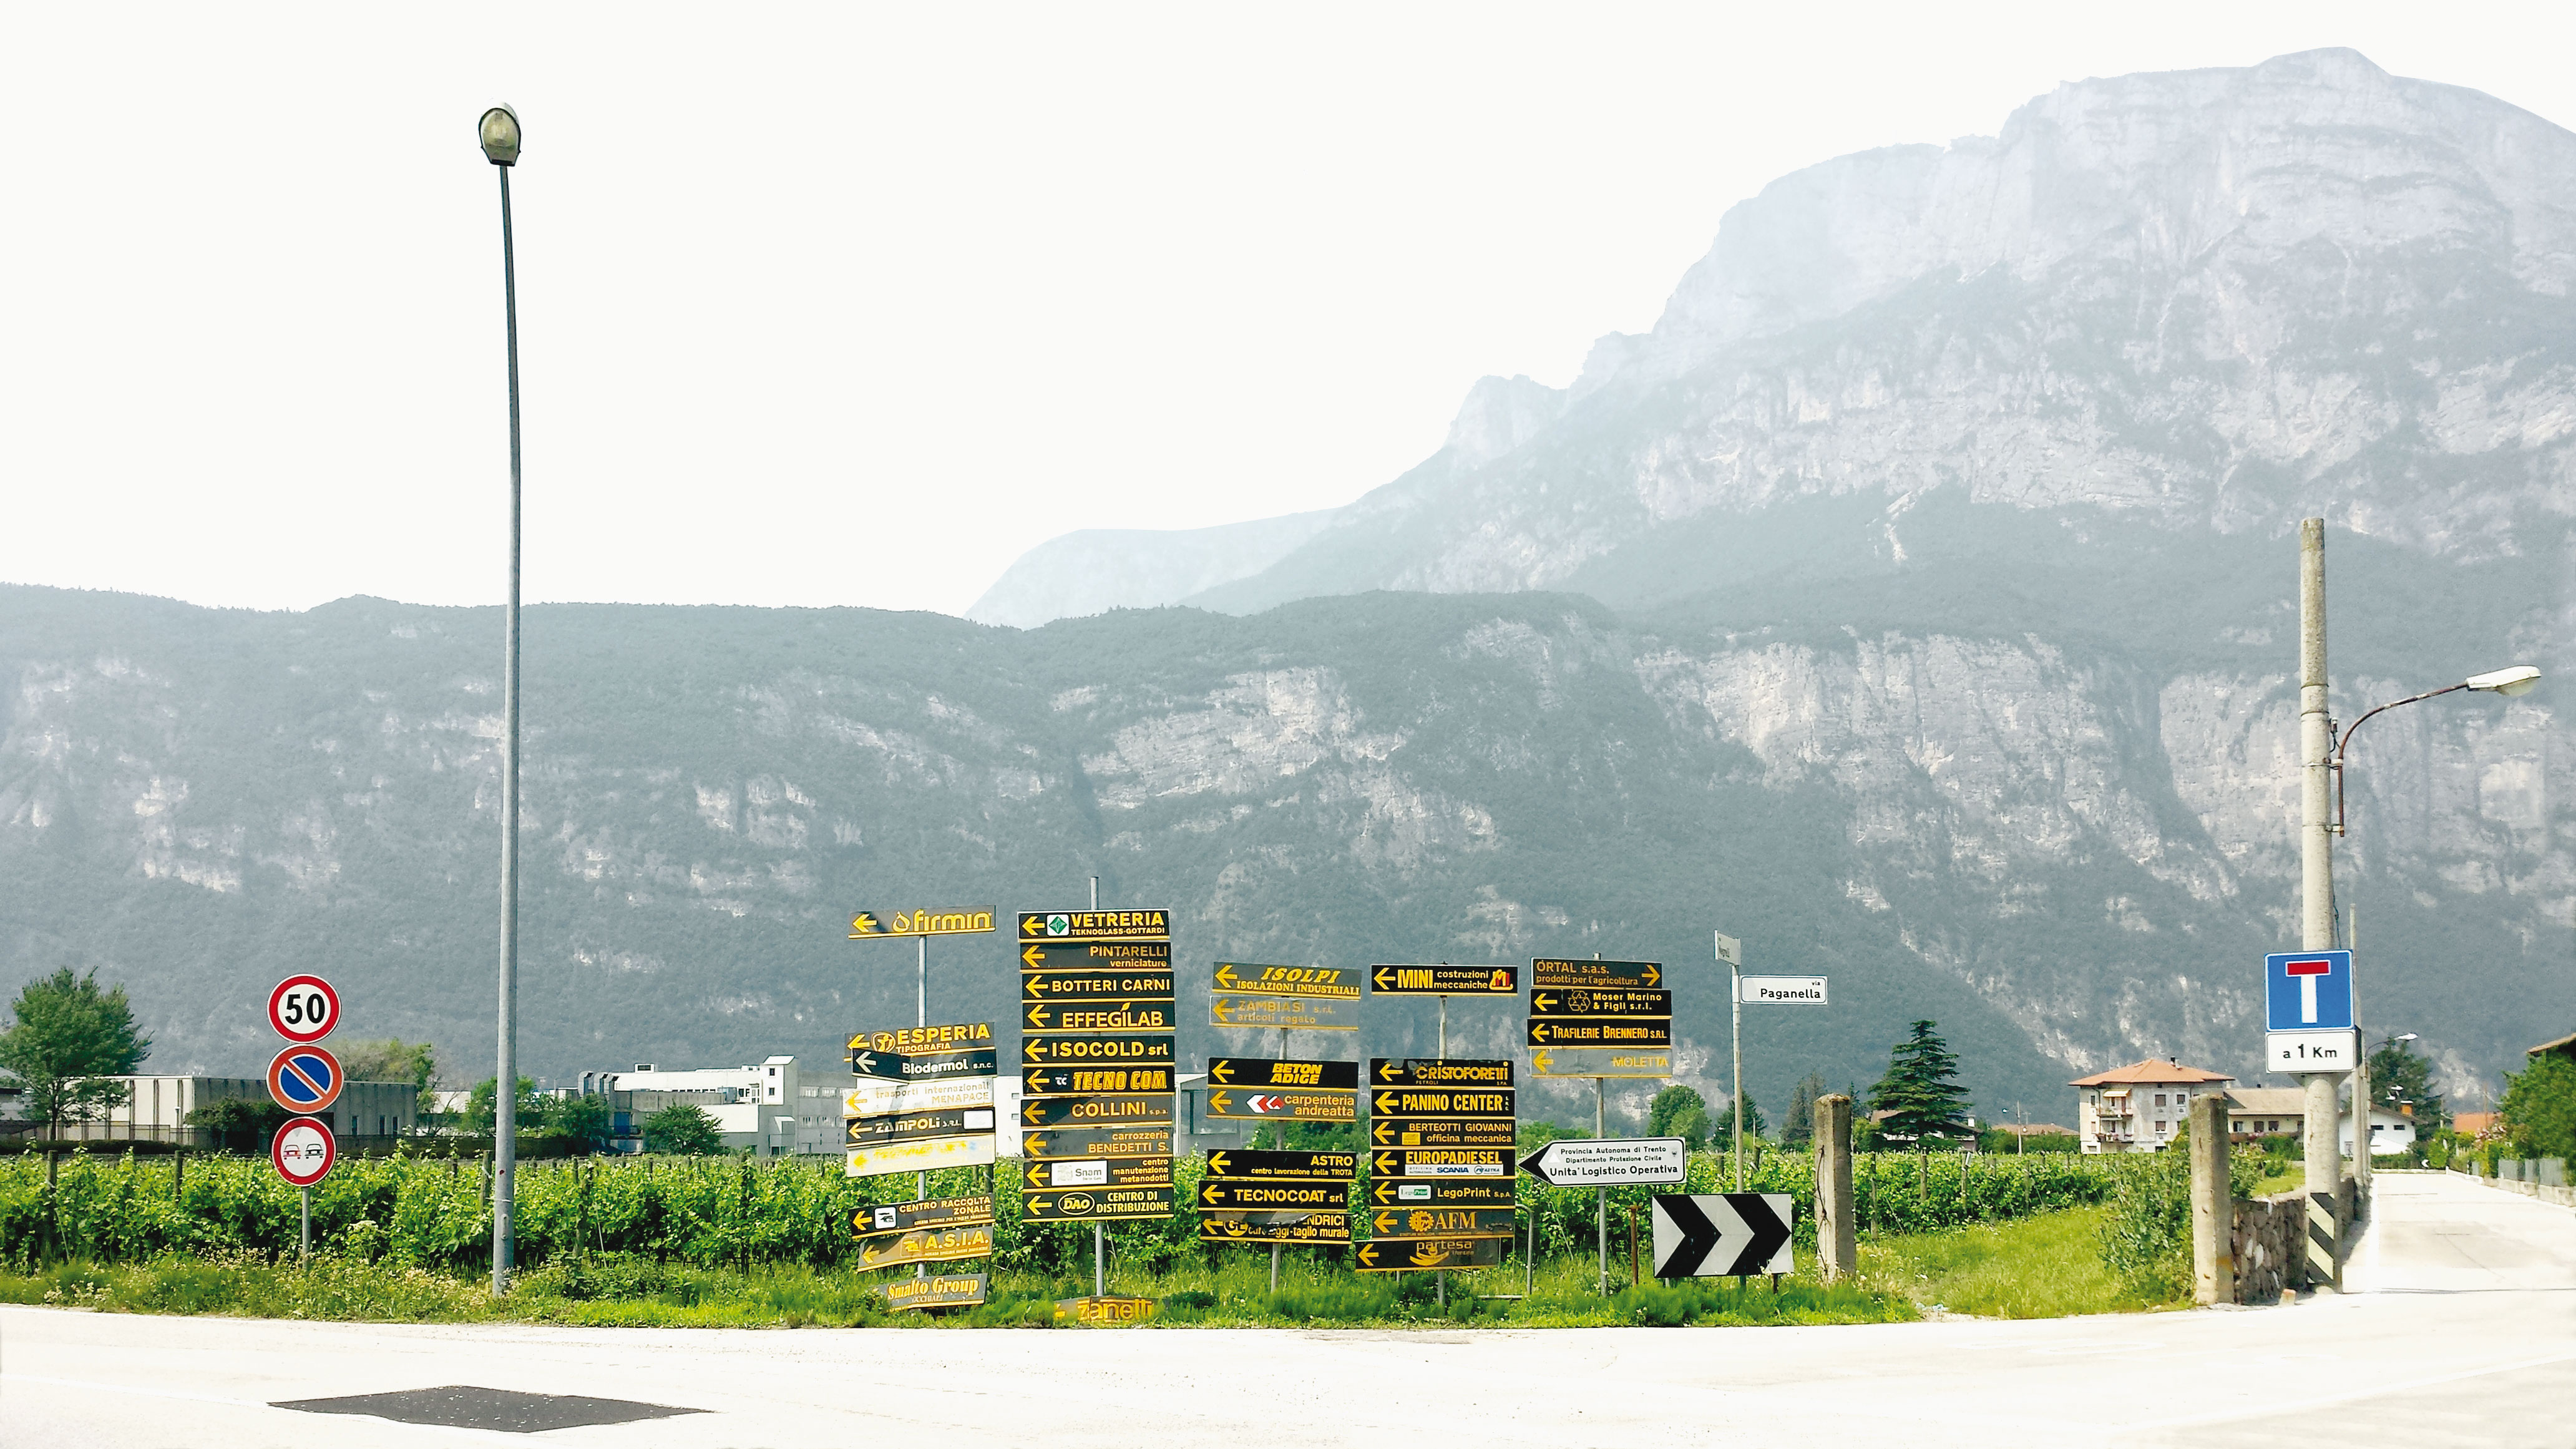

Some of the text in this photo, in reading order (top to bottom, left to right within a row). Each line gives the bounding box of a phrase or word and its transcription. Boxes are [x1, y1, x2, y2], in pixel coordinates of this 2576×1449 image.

[1071, 912, 1164, 927] VETRERIA
[1071, 927, 1165, 935] TEKNOGLASS-GOTTARDI
[1090, 946, 1167, 957] PINTARELLI
[1110, 959, 1167, 967] verniciature
[1536, 962, 1609, 974] ORTAL s.a.s.
[1261, 967, 1341, 983] ISOLPI
[1397, 970, 1433, 988] MINI
[1437, 970, 1488, 978] costruzioni
[1536, 975, 1571, 983] prodotti
[1051, 979, 1170, 992] BOTTERI CARNI
[1236, 980, 1359, 995] ISOLAZIONI INDUSTRIALI
[1434, 980, 1488, 989] meccaniche
[1627, 993, 1662, 1001] Marino
[1760, 988, 1820, 999] Paganella
[285, 993, 325, 1025] 50
[1237, 1000, 1305, 1013] ZAMBIASI
[1604, 1002, 1626, 1012] Figli
[1237, 1012, 1315, 1025] articoli regalo
[897, 1023, 991, 1045] ESPERIA
[895, 1043, 951, 1053] TIPOGRAFIA
[1052, 1042, 1168, 1057] ISOCOLD srl
[2283, 1043, 2337, 1058] a 1 Km
[902, 1059, 968, 1075] Biodermol
[1612, 1056, 1669, 1067] MOLETTA
[1272, 1063, 1323, 1074] BETON
[1073, 1071, 1166, 1090] TECNO COM
[1269, 1073, 1320, 1084] ADIGE
[876, 1081, 990, 1098] trasporti internazionali
[932, 1091, 990, 1104] MENAPACE
[1284, 1094, 1355, 1107] carpenteria
[1403, 1095, 1449, 1111] PANINO
[1453, 1095, 1503, 1111] CENTER
[1072, 1101, 1146, 1117] COLLINI
[1295, 1105, 1354, 1116] andreatta
[1409, 1123, 1511, 1132] BERTEOTTI GIOVANNI
[1112, 1131, 1168, 1140] carrozzeria
[1427, 1134, 1460, 1143] officina
[1464, 1134, 1512, 1143] meccanica
[1088, 1142, 1169, 1153] BENEDETTI S.
[1143, 1158, 1168, 1166] centro
[1310, 1155, 1353, 1166] ASTRO
[1405, 1151, 1503, 1164] EUROPADIESEL
[1075, 1168, 1101, 1177] Snam
[1113, 1166, 1168, 1176] manutenzione
[1582, 1166, 1626, 1177] Logistico
[1629, 1165, 1678, 1176] Operativa
[1120, 1173, 1168, 1183] metanodotti
[1108, 1191, 1158, 1202] CENTRO DI
[1234, 1189, 1344, 1203] TECNOCOAT srl
[1437, 1188, 1491, 1199] LegoPrint
[899, 1196, 992, 1213] CENTRO RACCOLTA
[953, 1204, 992, 1215] ZONALE
[1062, 1198, 1091, 1210] DAO
[1096, 1201, 1169, 1213] DISTRIBUZIONE
[1435, 1211, 1477, 1229] AFM
[1320, 1227, 1349, 1237] murale
[925, 1231, 989, 1249] A.S.I.A.
[1417, 1240, 1473, 1251] partesa
[887, 1277, 978, 1300] Smalto Group
